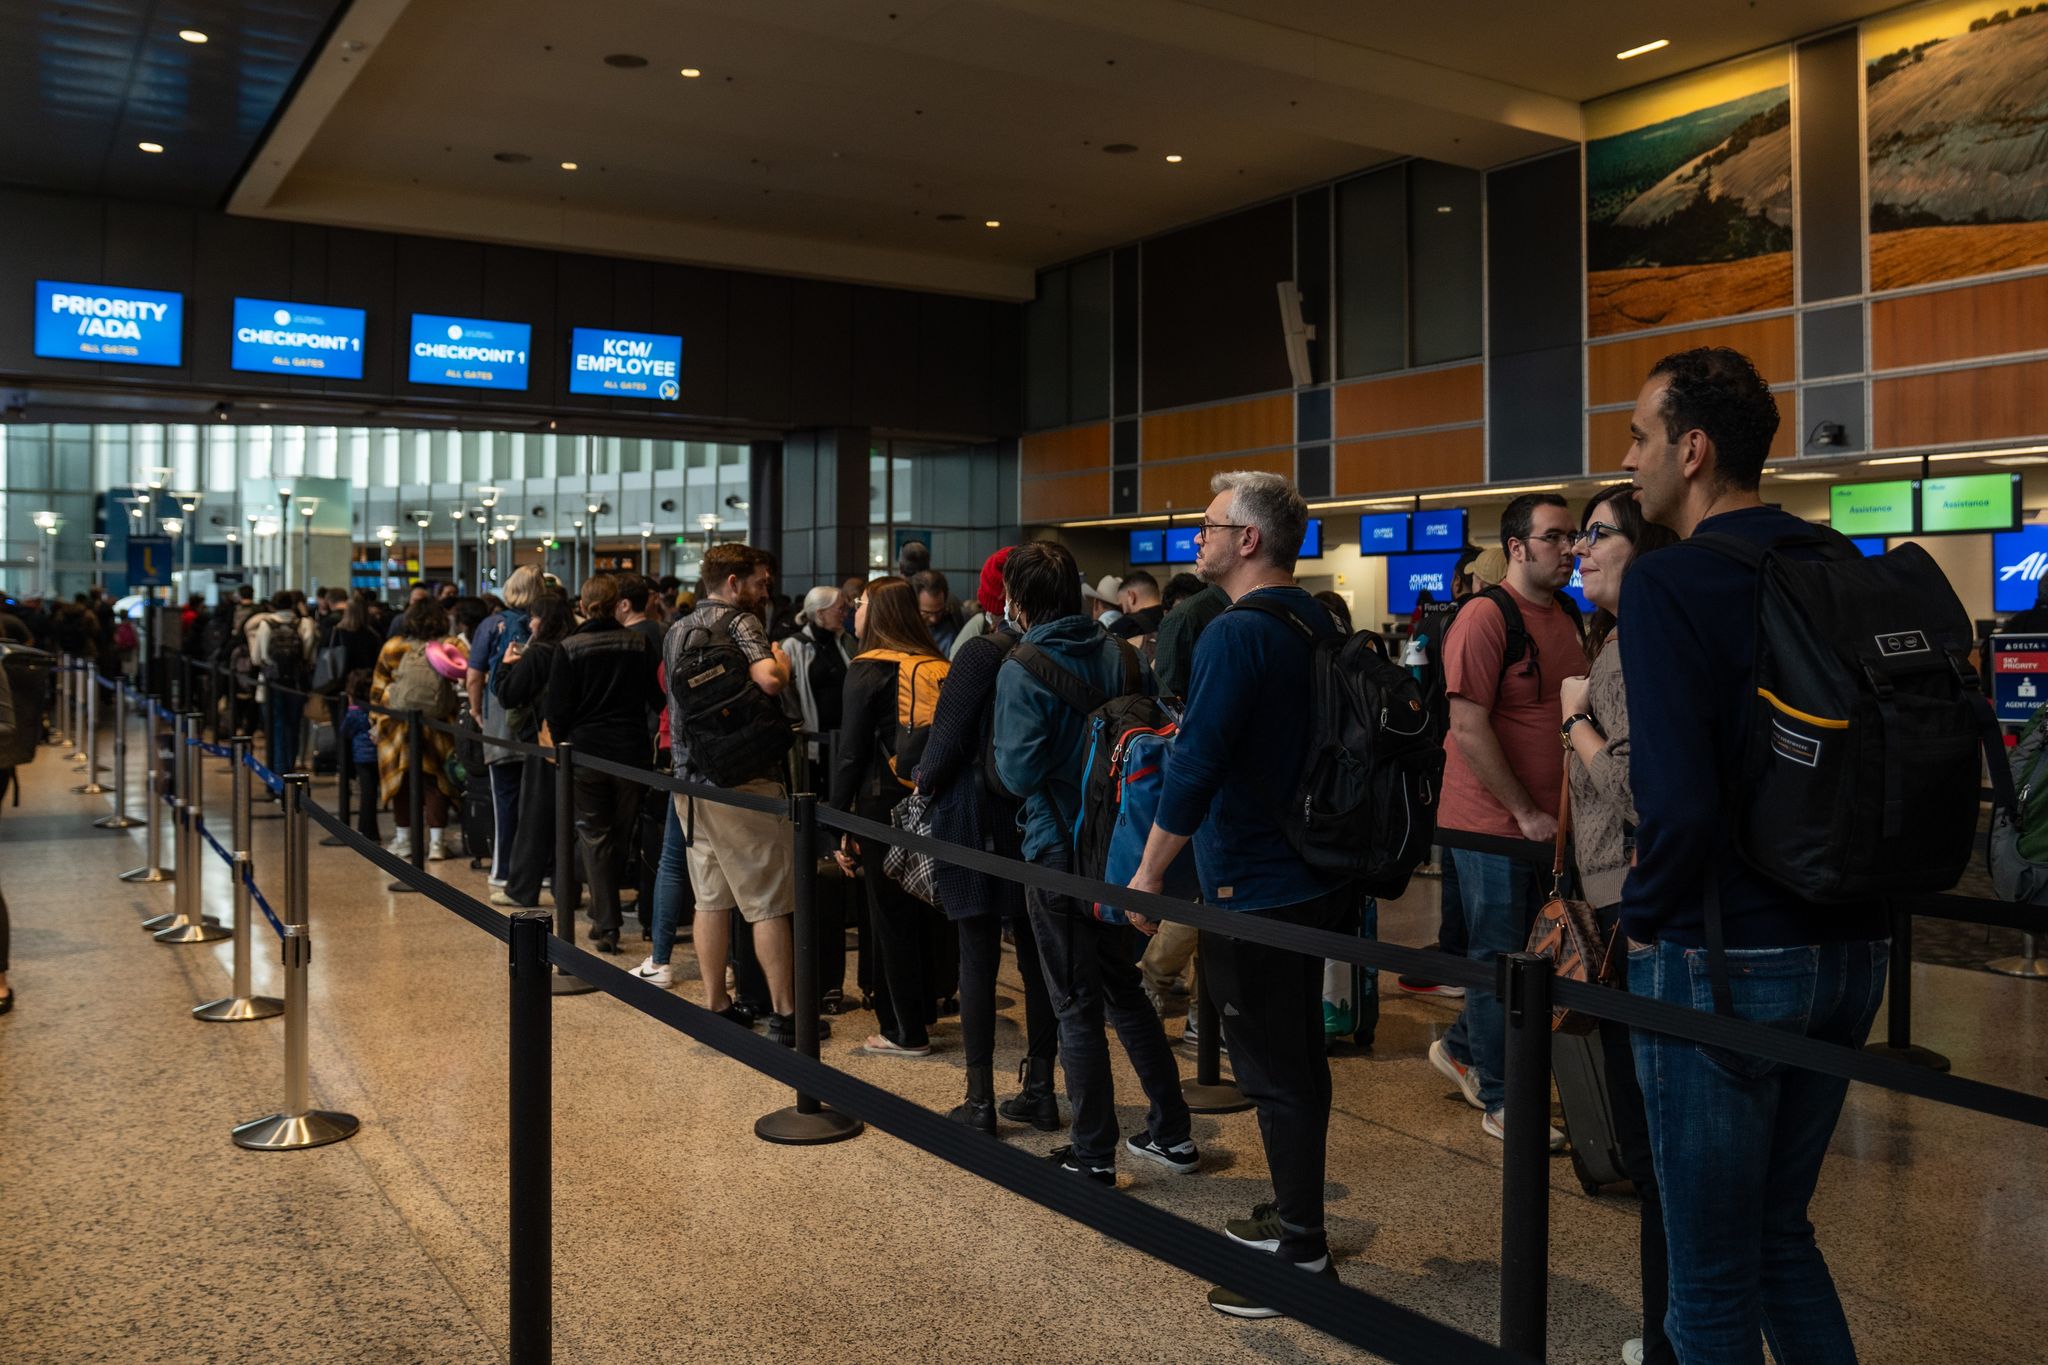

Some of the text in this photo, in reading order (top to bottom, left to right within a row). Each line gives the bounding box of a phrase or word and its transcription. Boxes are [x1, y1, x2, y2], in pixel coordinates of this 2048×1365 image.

[51, 293, 168, 322] PRIORITY
[77, 316, 142, 341] /ADA
[237, 327, 360, 353] CHECKPOINT 1
[101, 344, 139, 356] GATES
[414, 342, 526, 365] CHECKPOINT 1
[603, 338, 653, 358] KCM/
[291, 357, 325, 369] GATES
[576, 353, 676, 378] EMPLOYEE
[463, 370, 493, 381] GATES
[1849, 504, 1892, 515] Assistance
[1943, 499, 1988, 510] Assistance
[1410, 574, 1442, 583] JOURNEY
[1428, 581, 1443, 591] AUS
[1424, 603, 1439, 611] First
